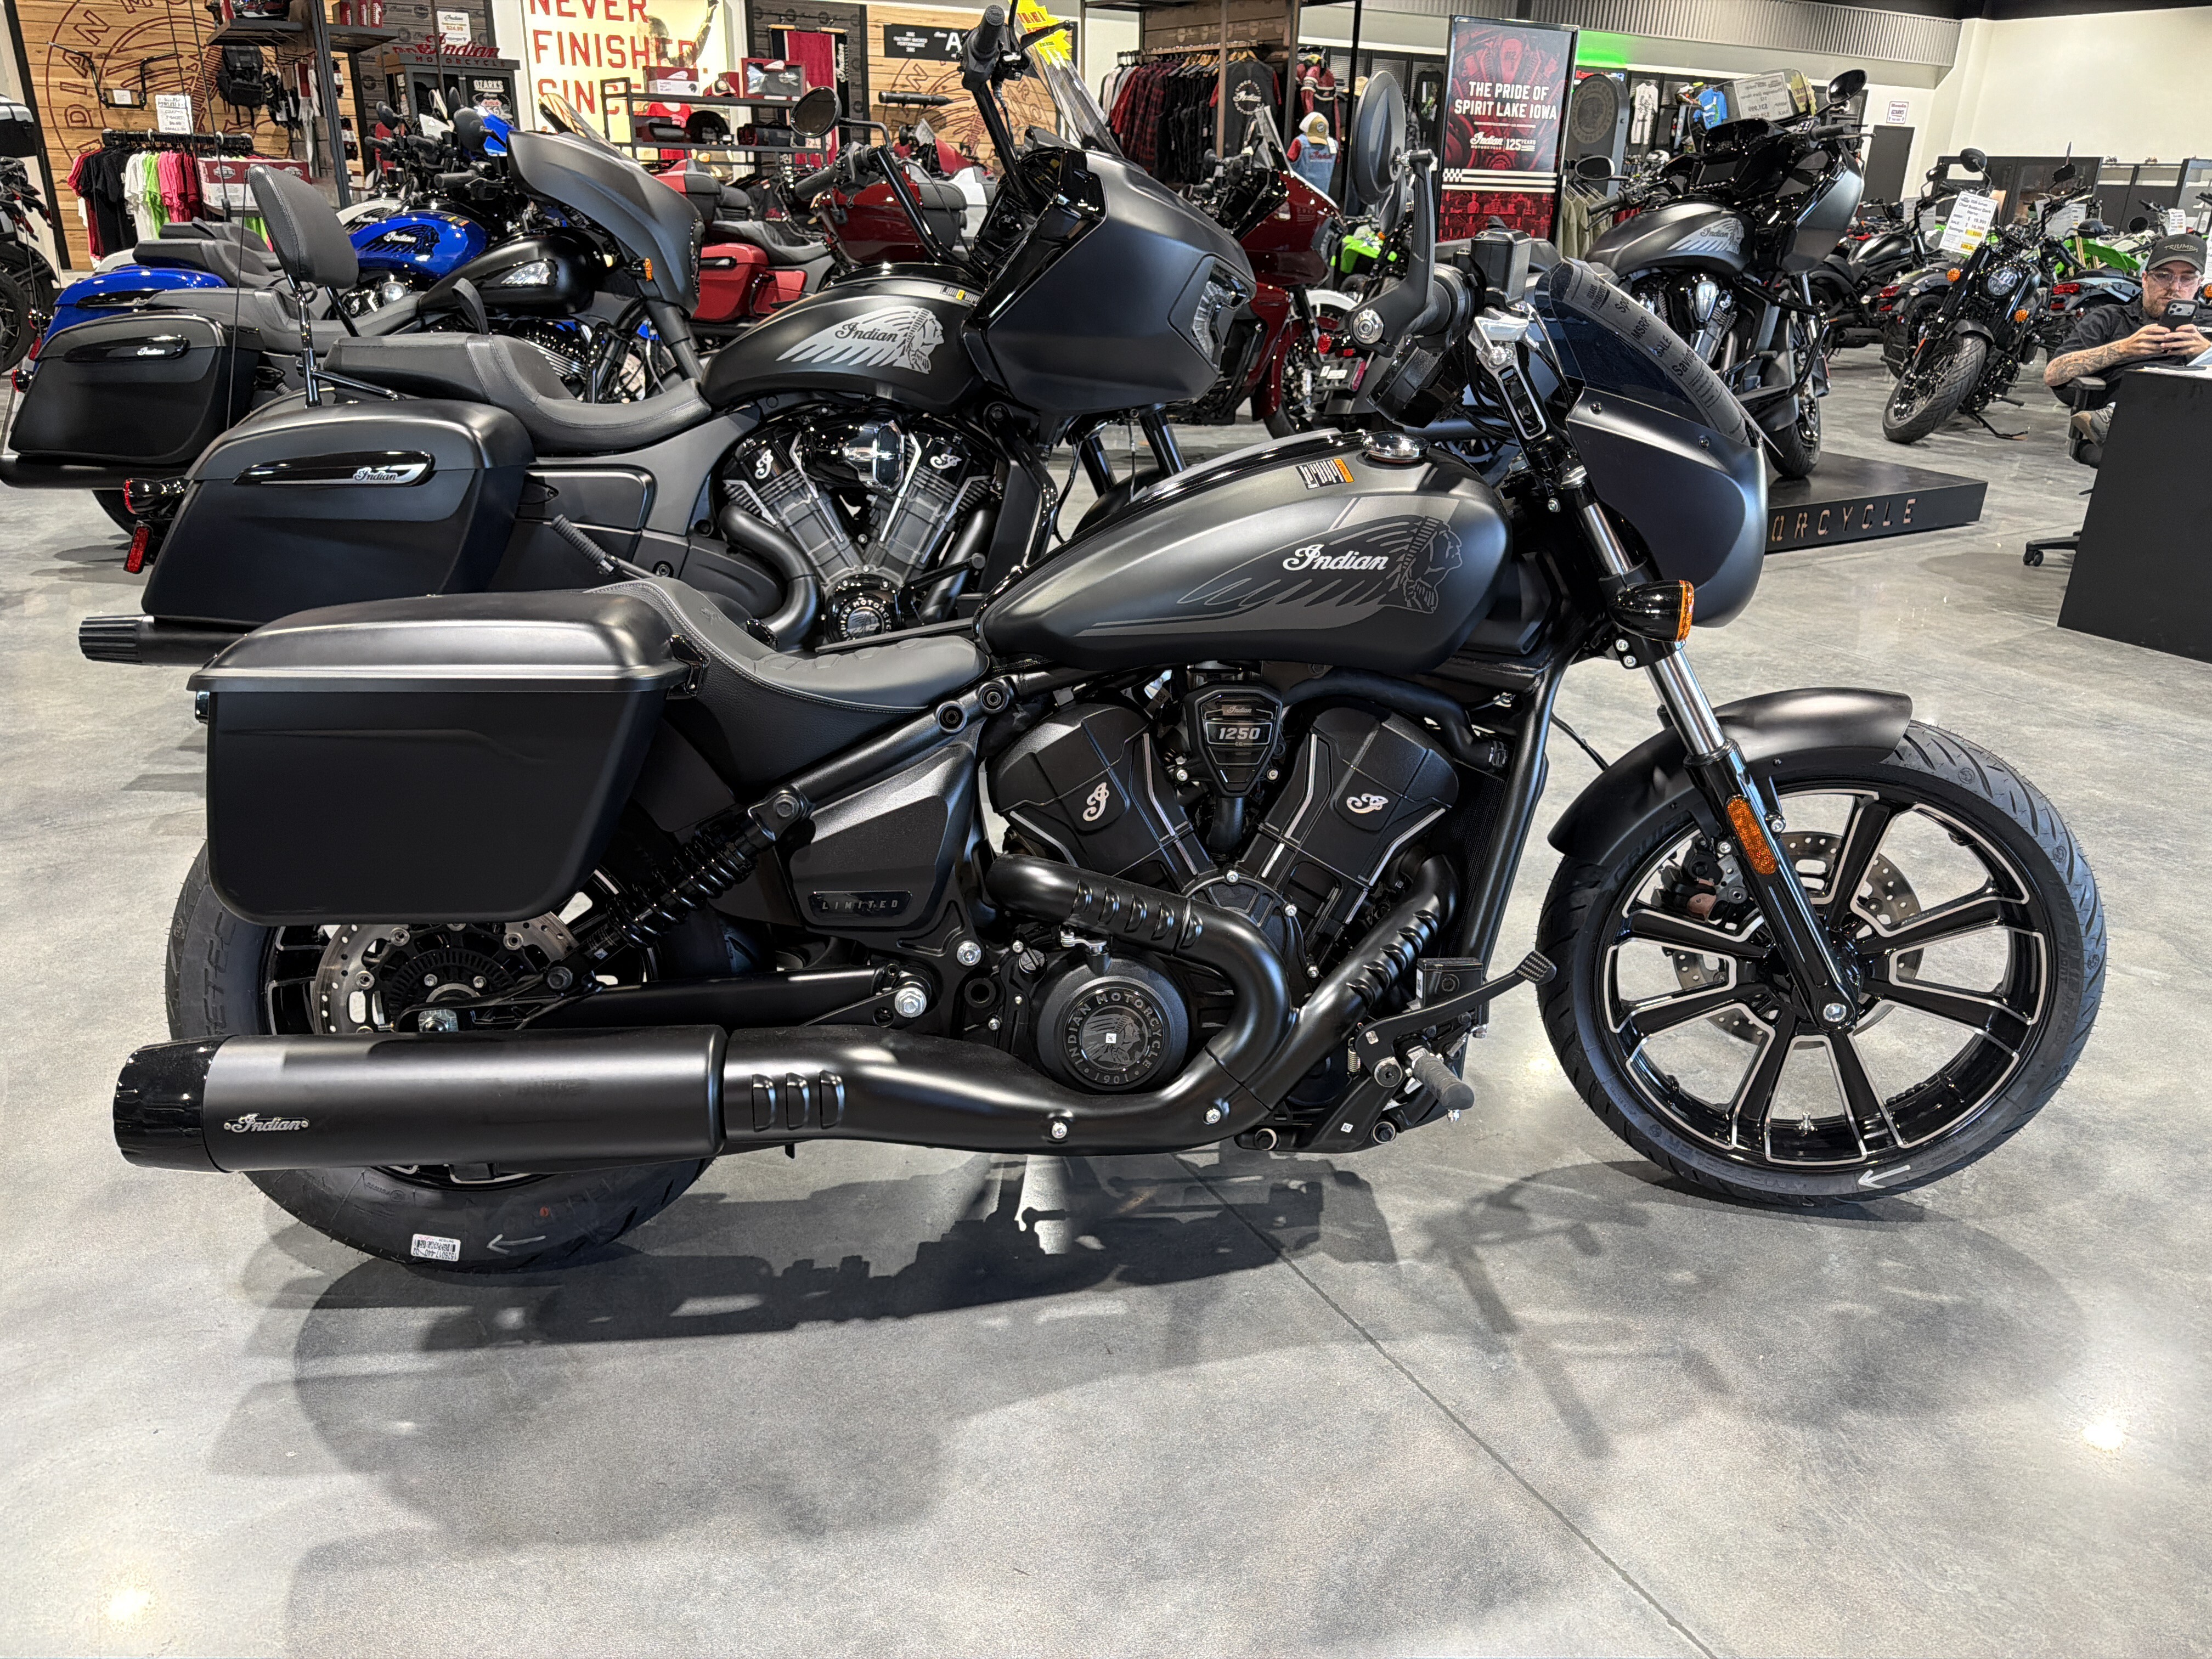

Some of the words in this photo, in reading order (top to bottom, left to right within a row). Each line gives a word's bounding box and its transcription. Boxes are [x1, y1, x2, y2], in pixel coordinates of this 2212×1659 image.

[416, 32, 500, 59] Indian
[415, 57, 505, 67] MOORCYCLE
[473, 80, 504, 89] OZARKS
[1469, 81, 1493, 97] THE
[1494, 83, 1531, 100] PRIDE
[1532, 86, 1549, 100] OF
[1454, 99, 1494, 116] SPIRIT
[1496, 101, 1527, 119] LAKE
[1529, 104, 1557, 120] IOWA
[1470, 132, 1504, 145] Indian
[1505, 138, 1521, 151] 125
[383, 231, 417, 243] Indian
[1700, 227, 1729, 238] Indian
[2164, 244, 2198, 253] TRIUMPH
[834, 322, 899, 342] Indian
[137, 346, 166, 356] Indian
[1656, 335, 1673, 358] SALE
[1672, 347, 1698, 377] Saving
[353, 469, 396, 481] Indian
[1771, 498, 1916, 541] ORCYCLE
[1282, 544, 1390, 571] Indian
[1227, 705, 1252, 714] Indian
[1218, 727, 1261, 740] 1250
[822, 900, 899, 910] LIMITED
[1067, 1003, 1092, 1066] INDIAN
[1095, 991, 1163, 1069] MOTORCYCLE
[230, 1113, 301, 1133] Indian
